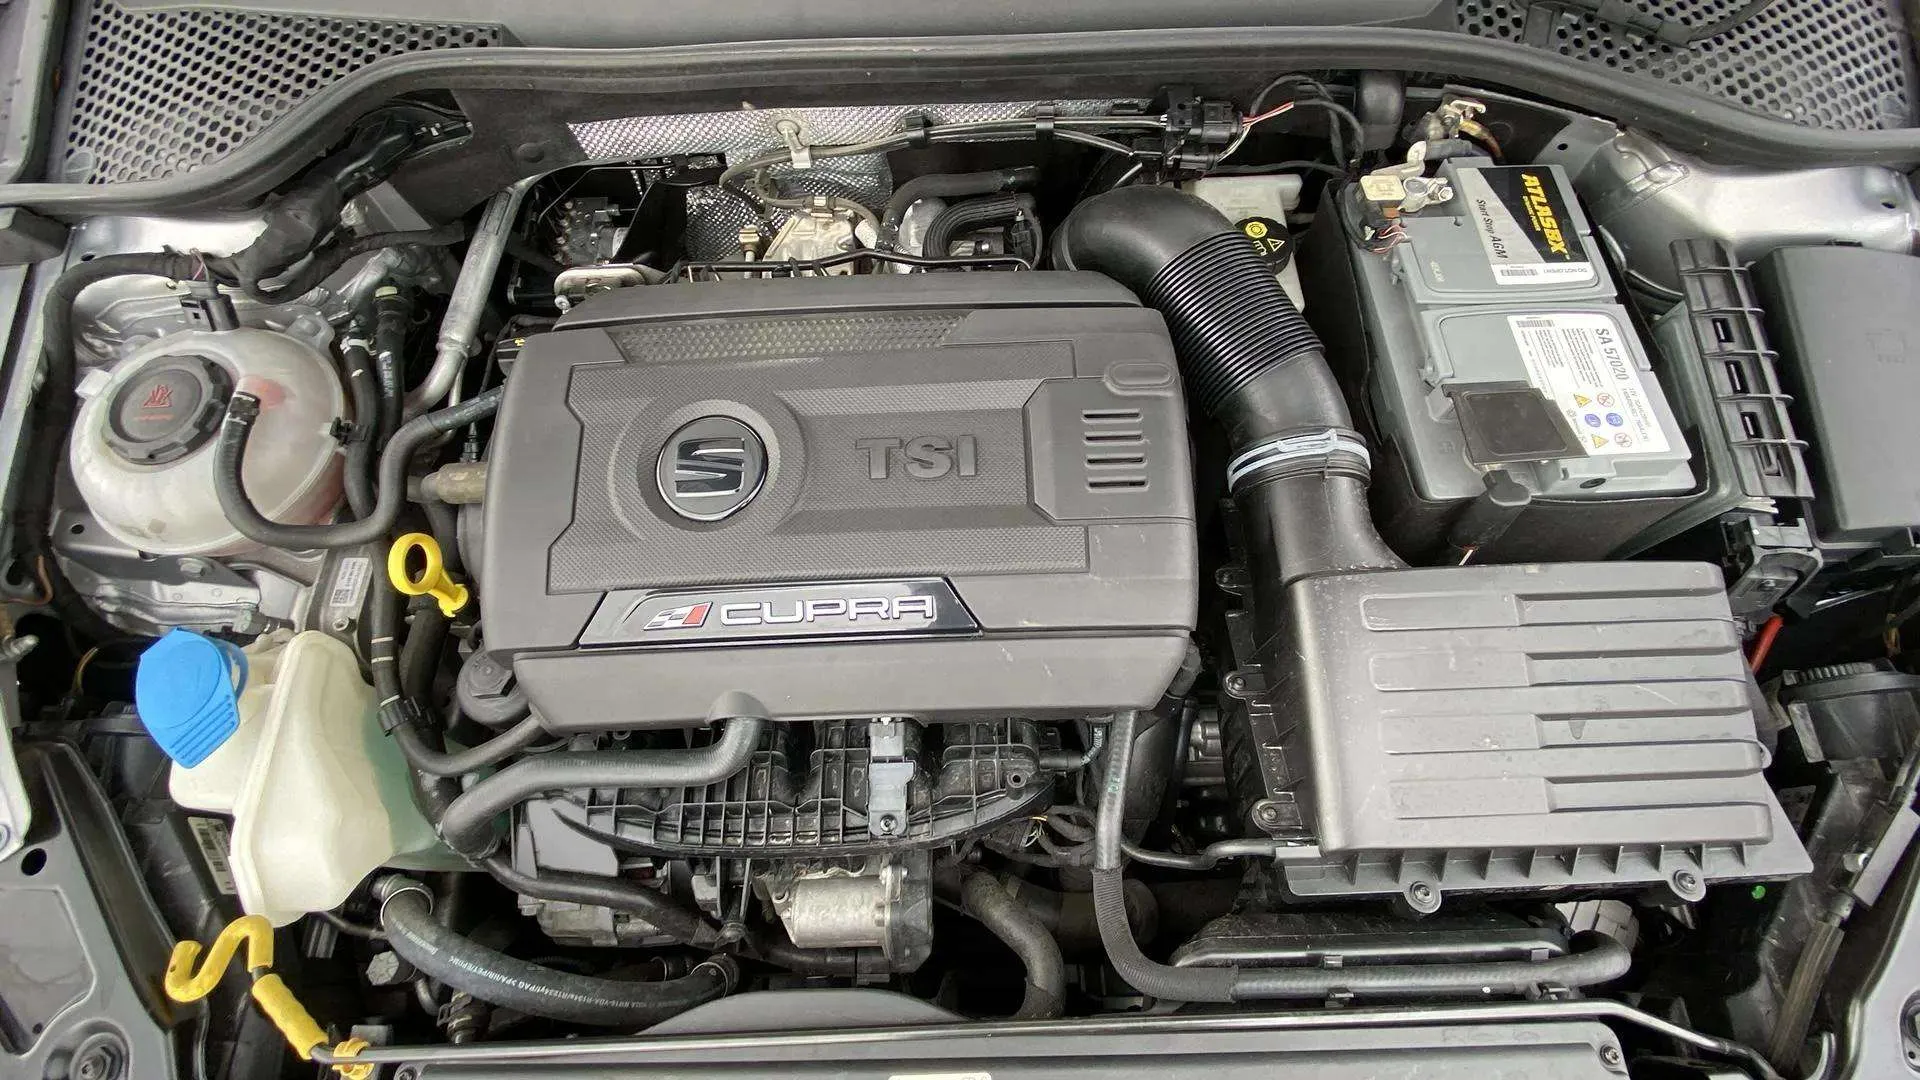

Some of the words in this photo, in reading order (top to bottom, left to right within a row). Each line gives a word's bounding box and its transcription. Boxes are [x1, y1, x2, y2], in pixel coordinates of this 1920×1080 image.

[1476, 199, 1490, 218] Start
[1483, 215, 1496, 236] Stop
[1490, 235, 1509, 260] AGM
[1521, 173, 1568, 254] ATLASBX
[1595, 328, 1613, 345] SA
[1604, 349, 1630, 381] 57020
[855, 434, 978, 480] TSI
[720, 595, 937, 627] CUPRA
